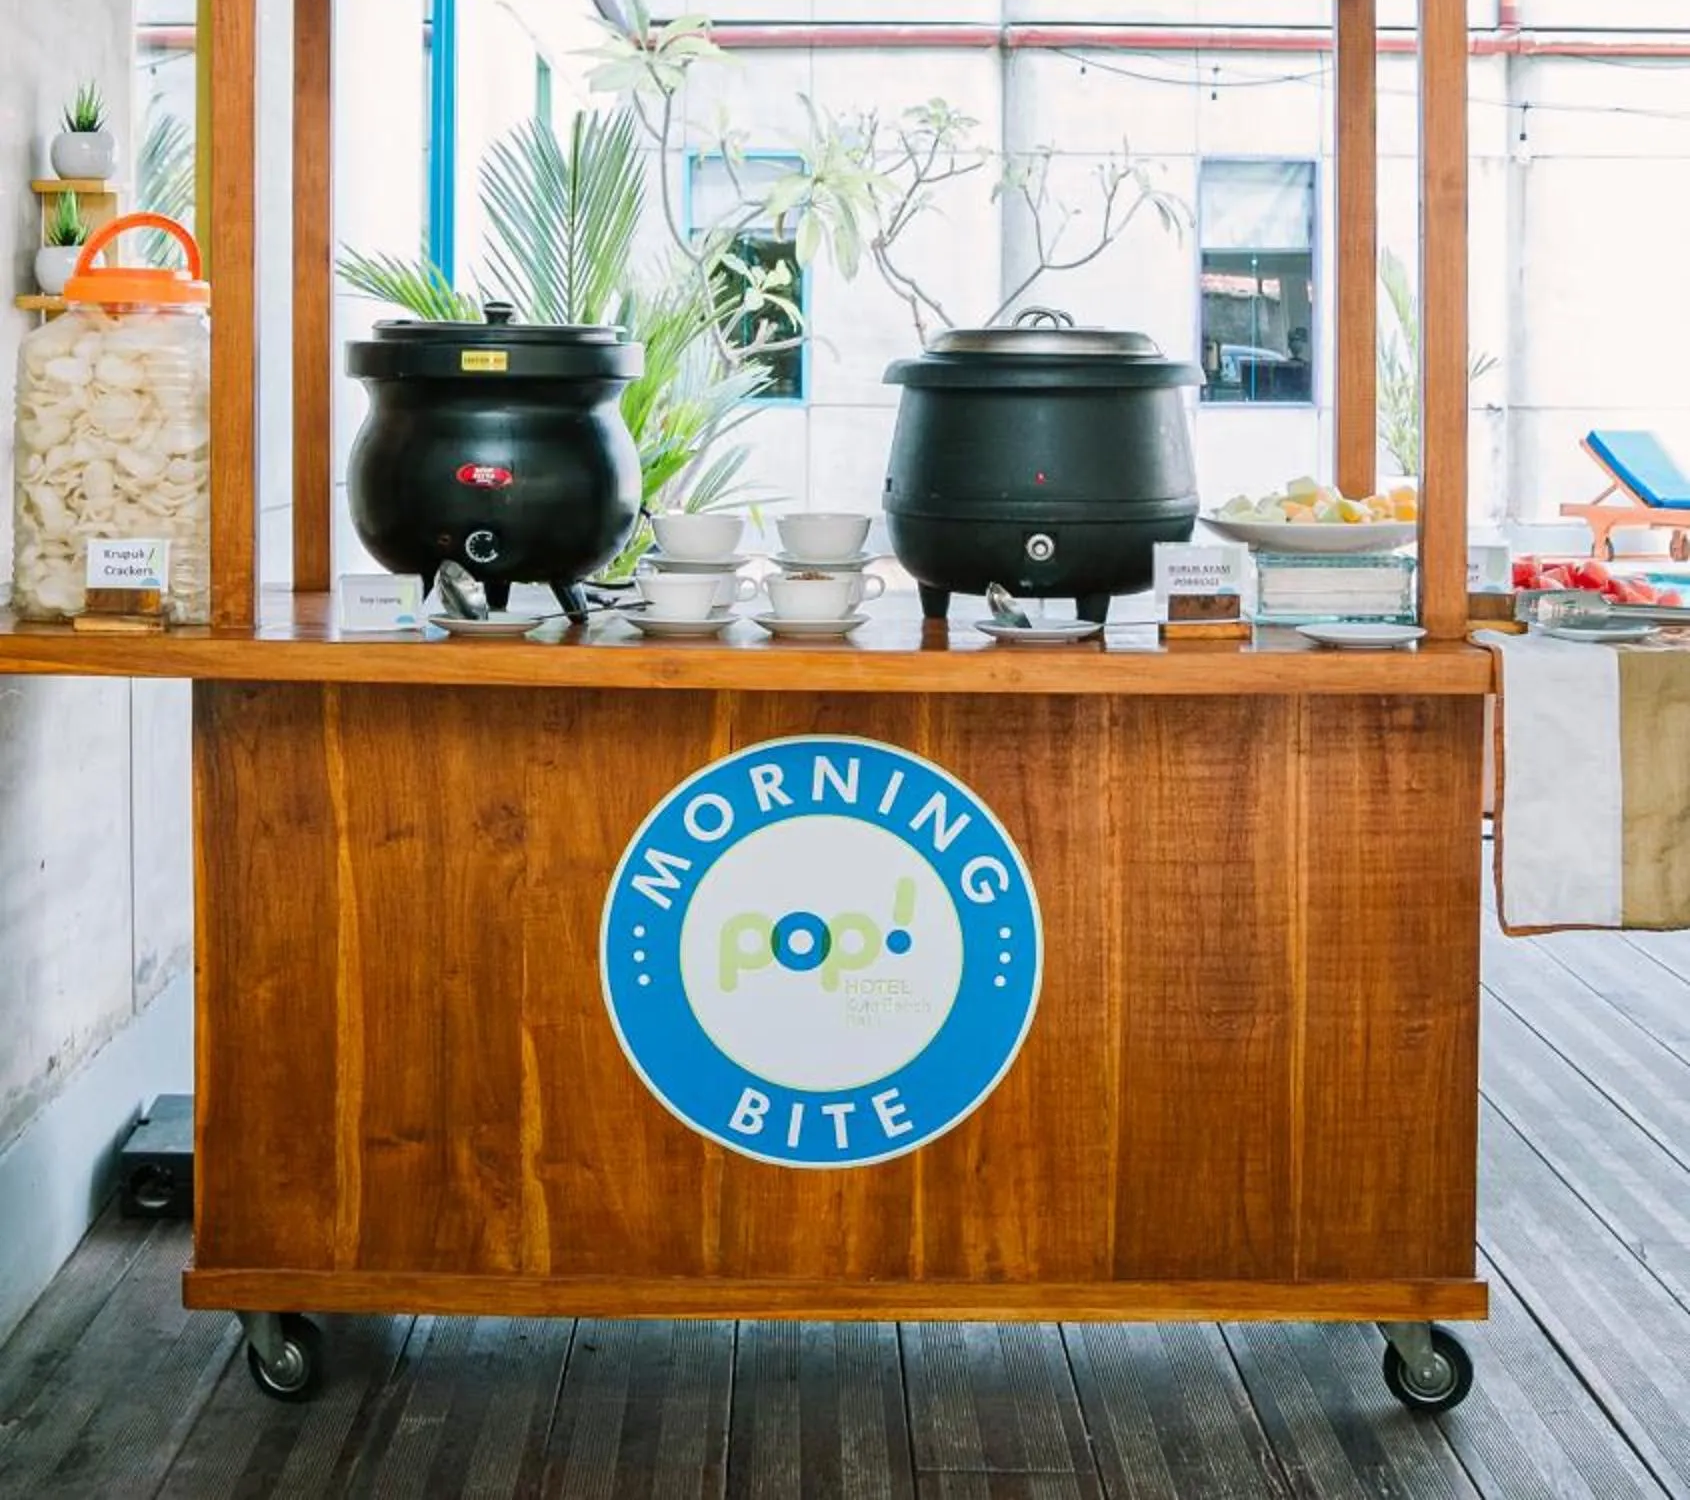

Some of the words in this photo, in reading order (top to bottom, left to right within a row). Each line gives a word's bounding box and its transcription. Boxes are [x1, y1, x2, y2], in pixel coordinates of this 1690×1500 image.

[103, 548, 145, 561] Krupuk
[103, 564, 154, 577] Crackers
[631, 756, 1010, 910] MORNING
[845, 978, 911, 995] HOTEL
[728, 1087, 914, 1149] BITE
